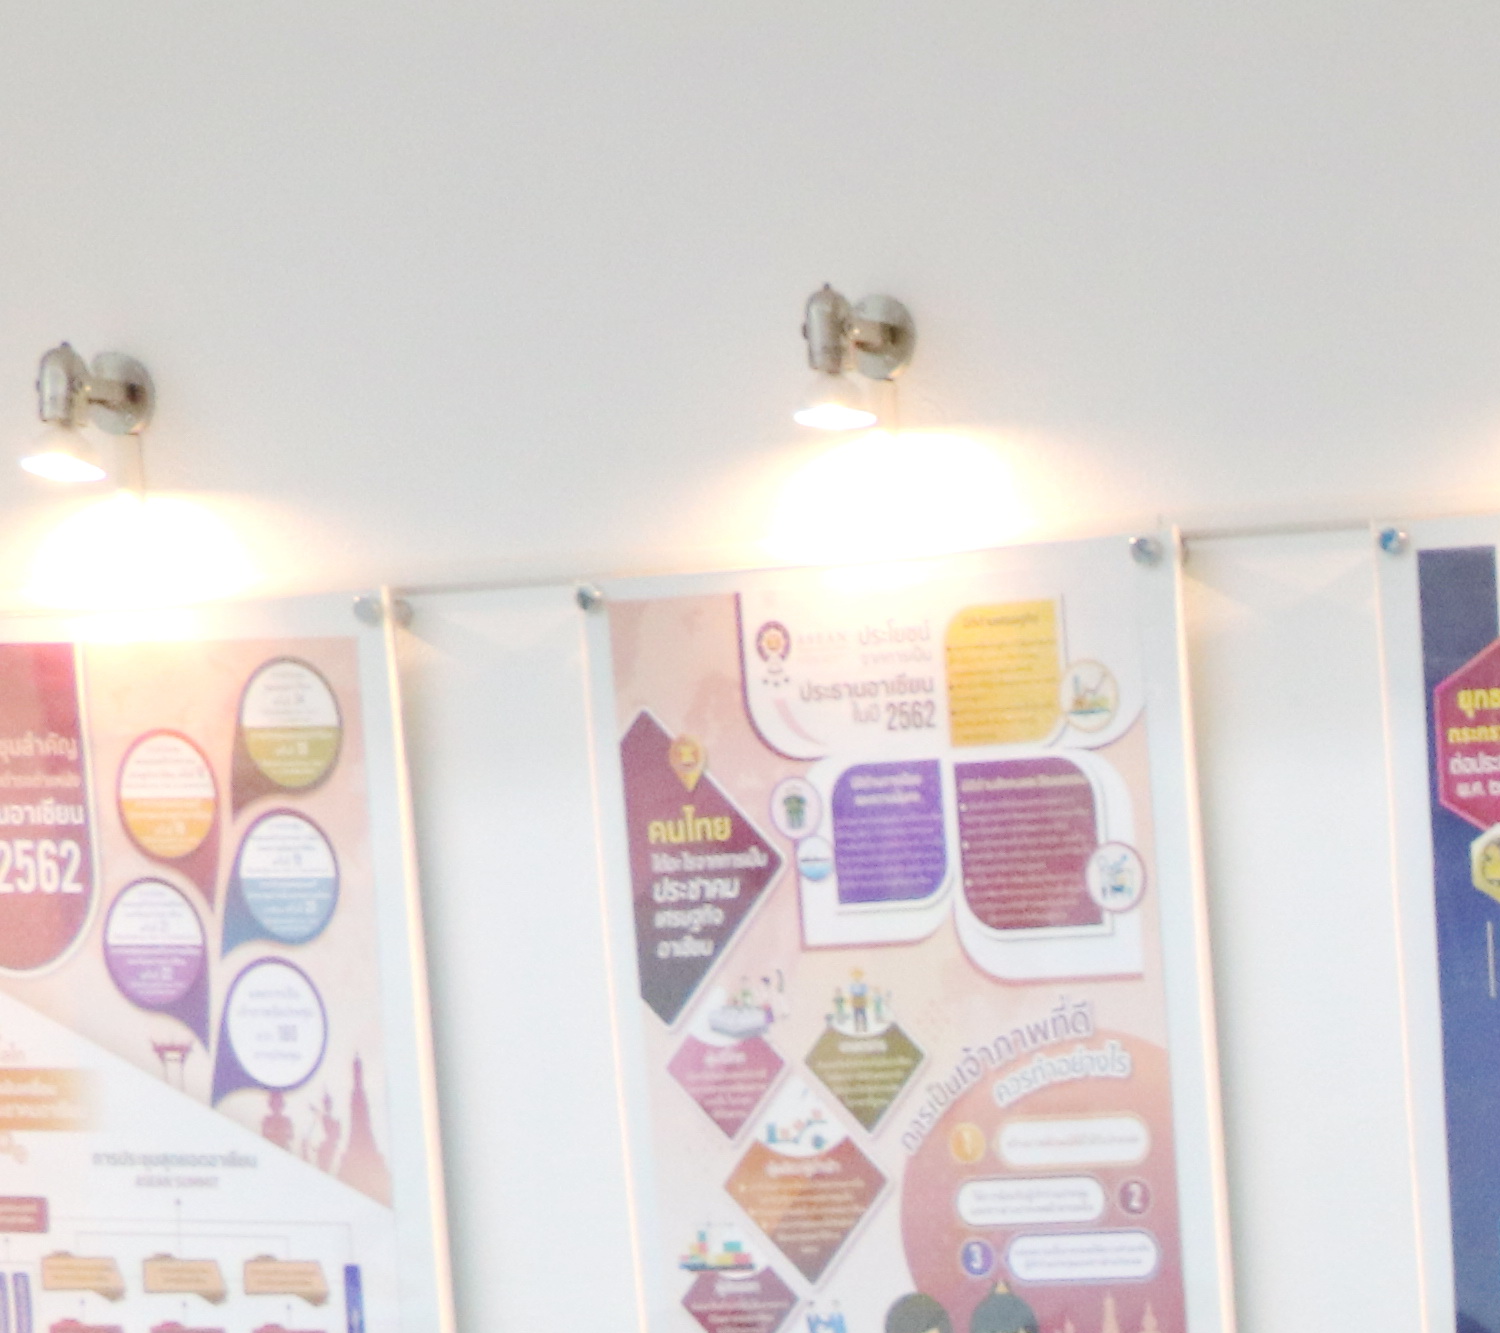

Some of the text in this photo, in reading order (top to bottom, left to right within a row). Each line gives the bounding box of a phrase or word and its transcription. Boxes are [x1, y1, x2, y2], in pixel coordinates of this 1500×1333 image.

[801, 673, 934, 702] ประธานอาเซียน
[887, 699, 936, 731] 2562
[648, 805, 732, 844] คนไทย
[0, 839, 83, 894] 2562
[652, 876, 741, 903] ประชาคม
[901, 995, 1094, 1153] การเป็นเจ้าภาพที่ดี
